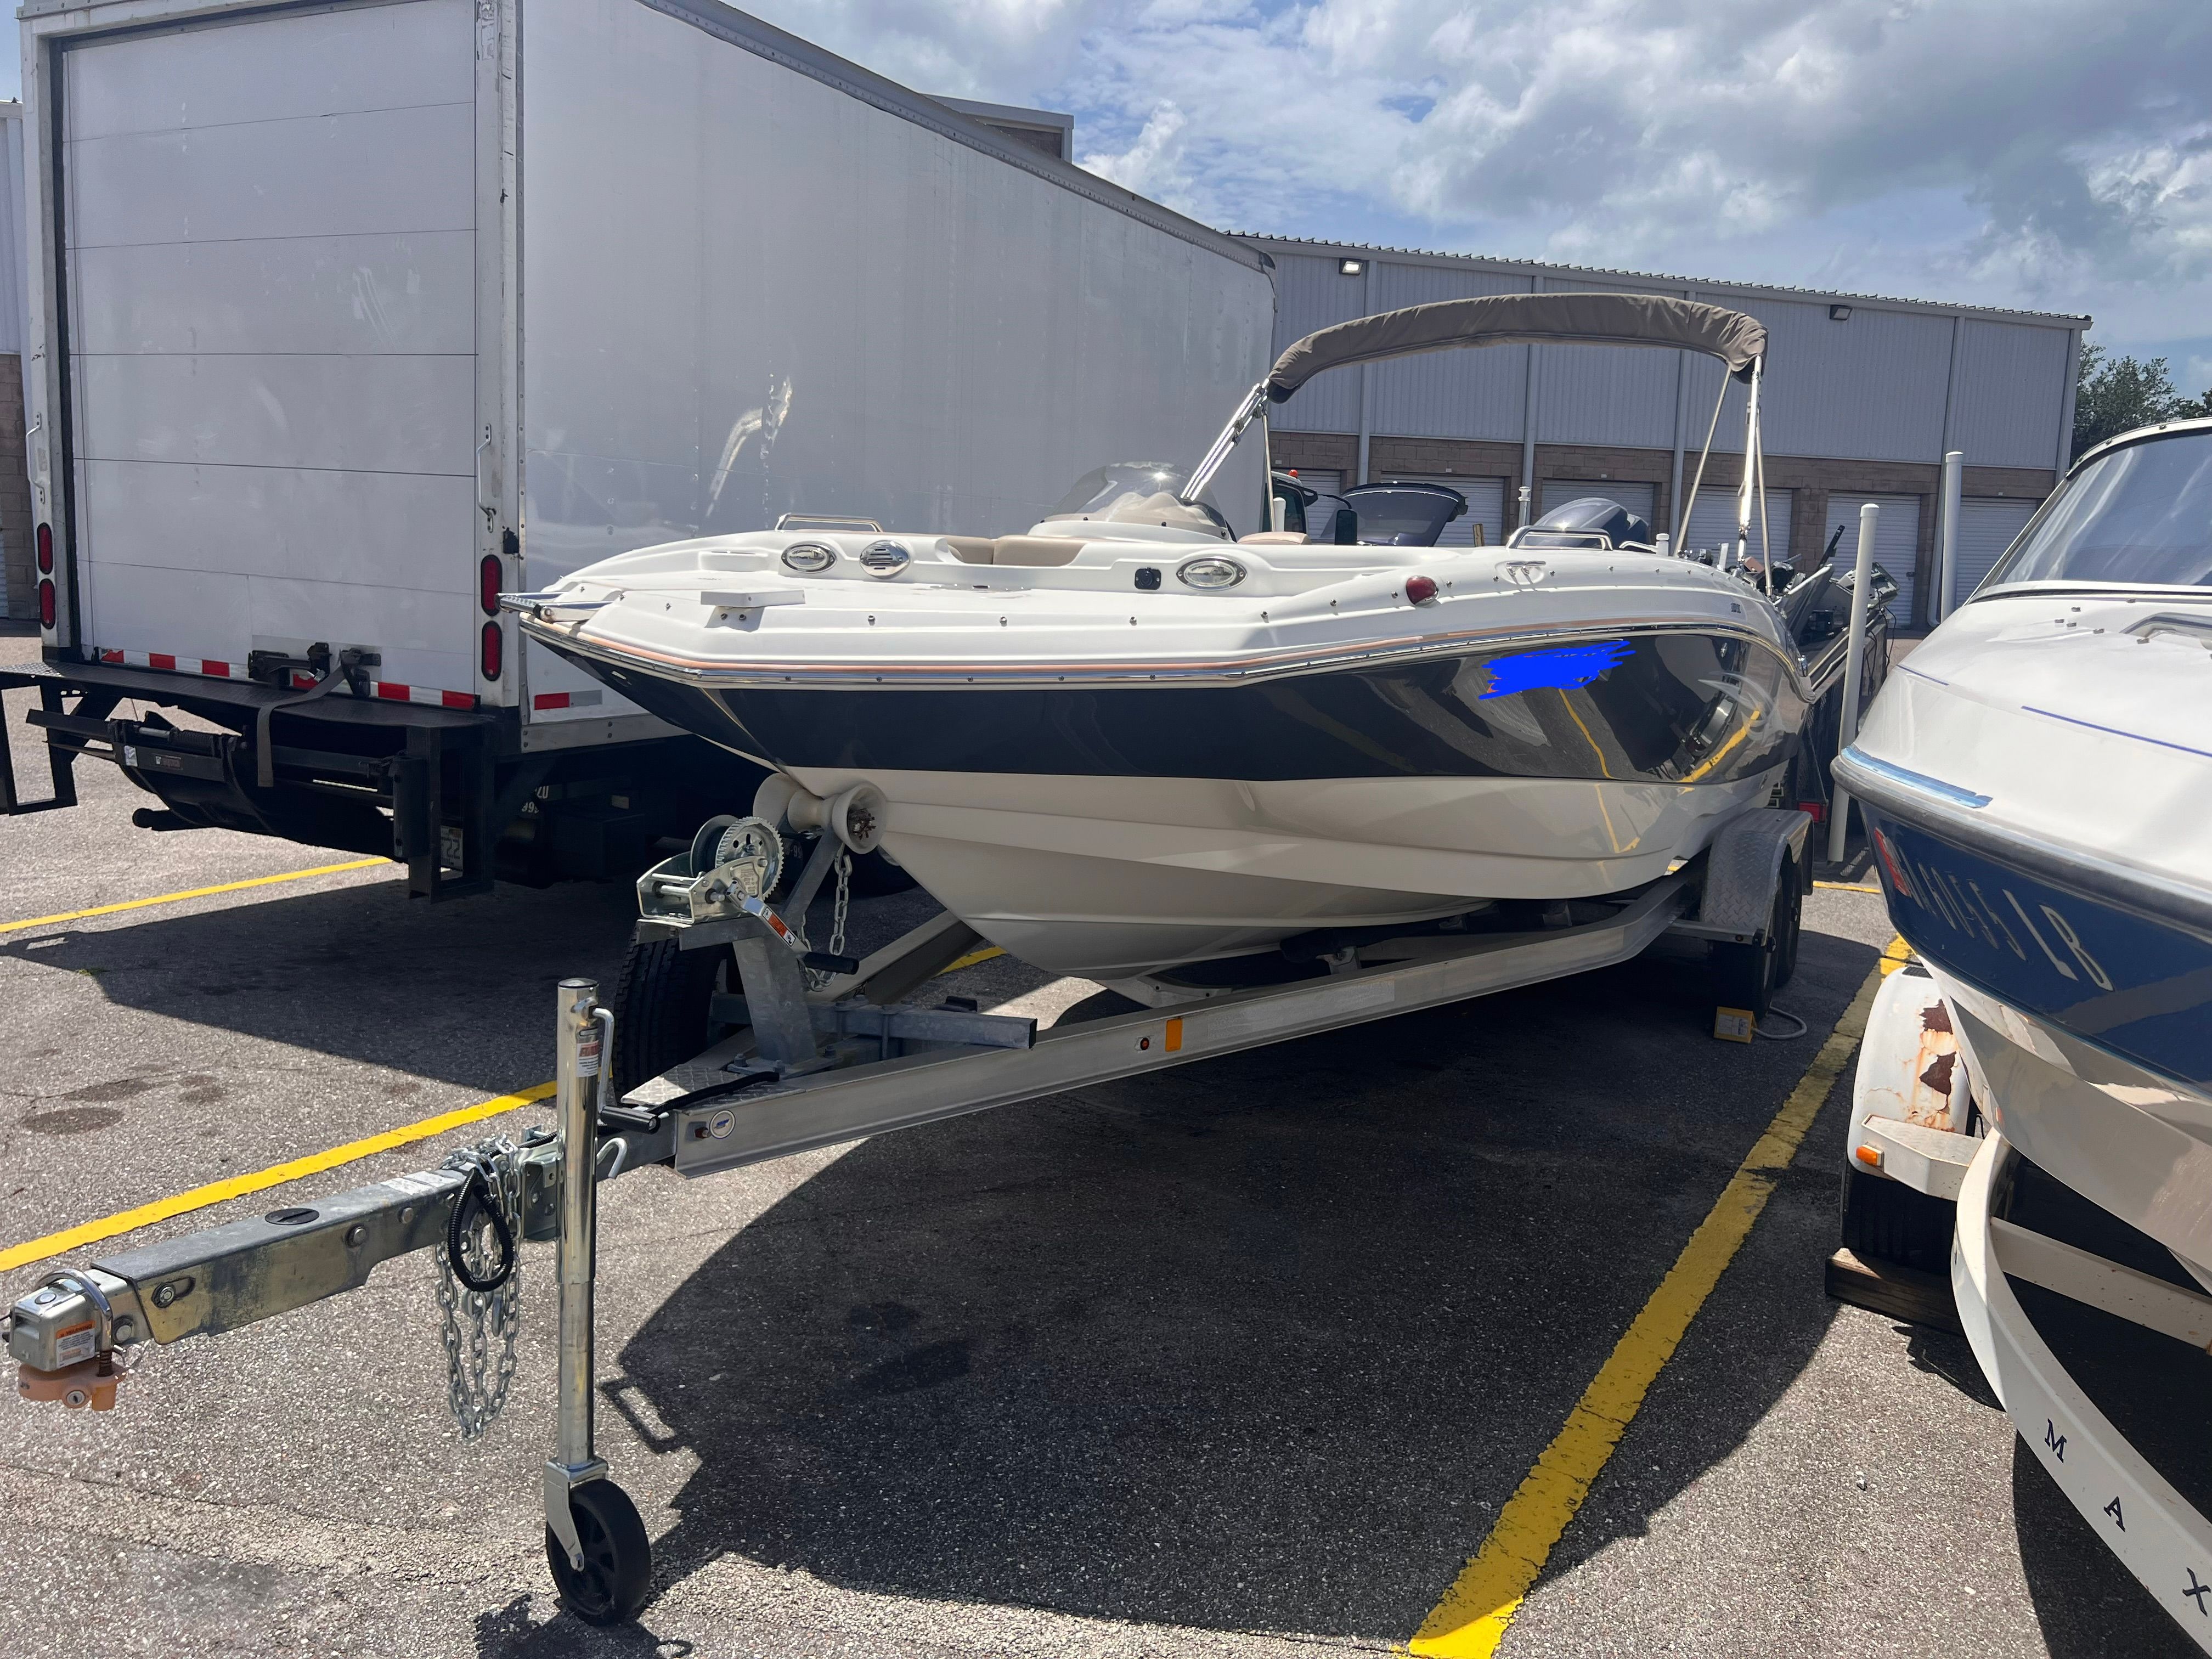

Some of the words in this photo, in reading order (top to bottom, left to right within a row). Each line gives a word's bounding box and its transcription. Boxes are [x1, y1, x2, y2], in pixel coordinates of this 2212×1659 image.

[1918, 862, 2026, 961] 6055
[2002, 889, 2113, 991] LB
[66, 1324, 93, 1335] WARNING
